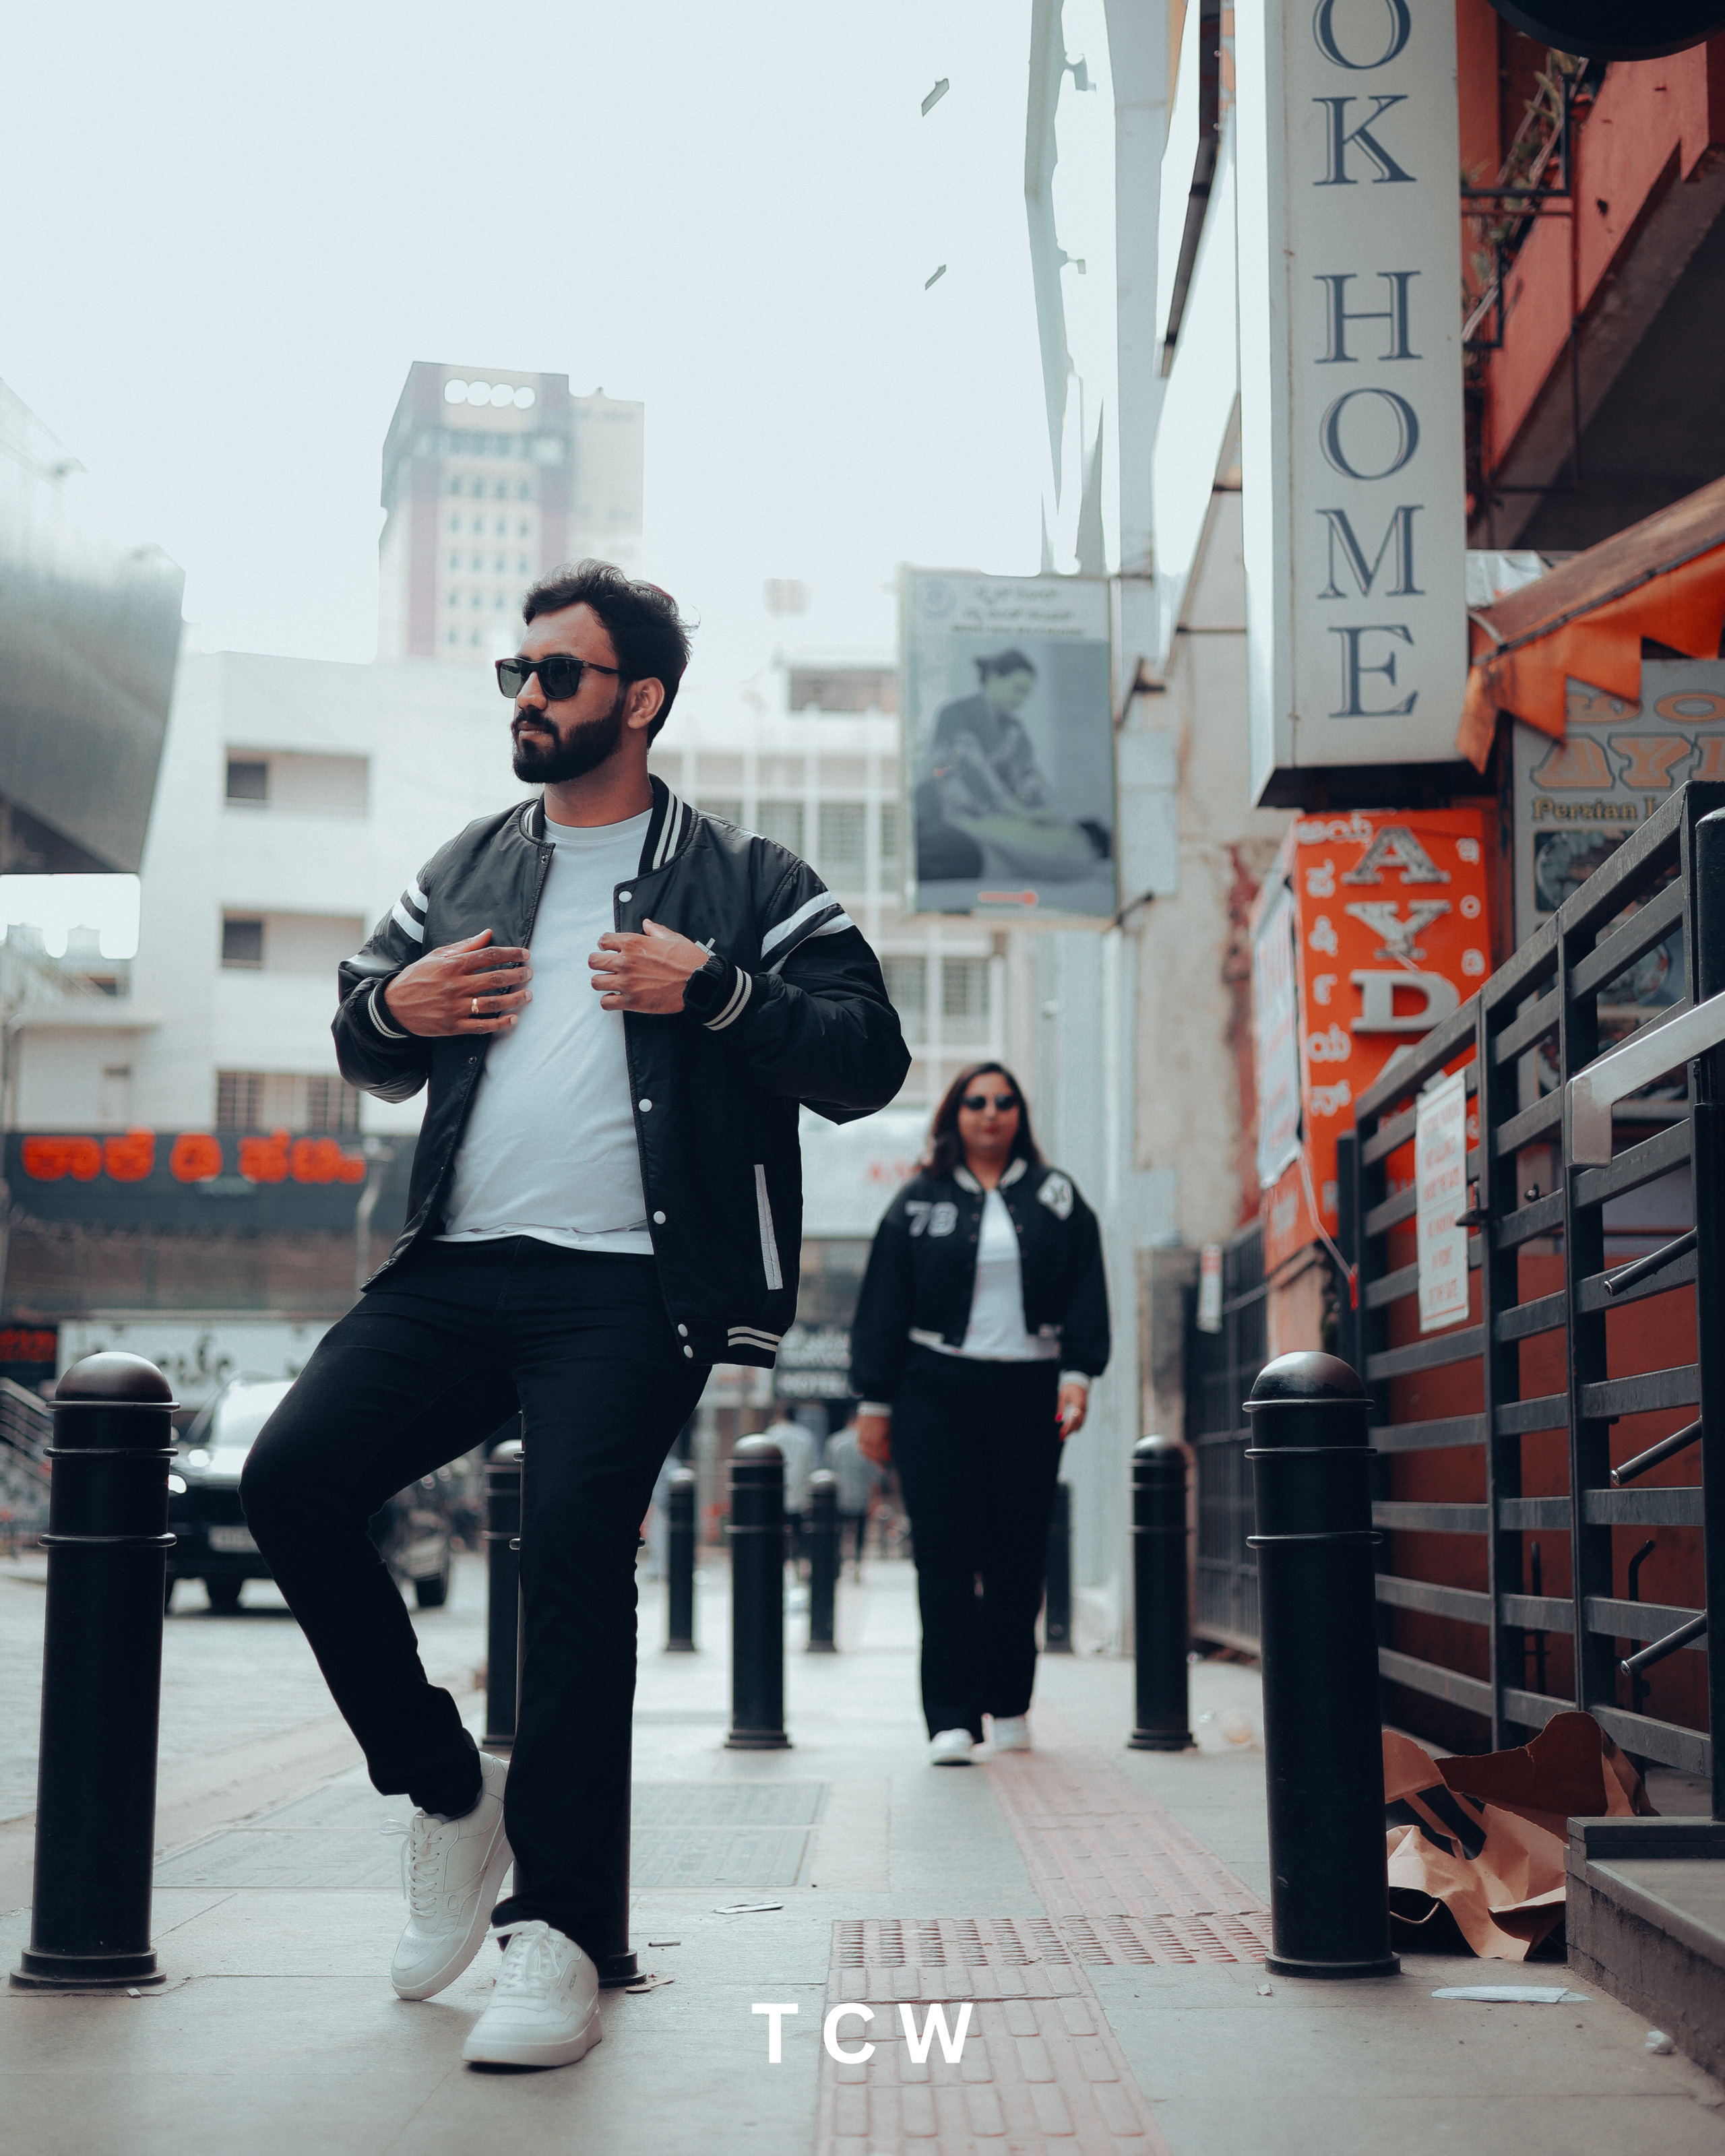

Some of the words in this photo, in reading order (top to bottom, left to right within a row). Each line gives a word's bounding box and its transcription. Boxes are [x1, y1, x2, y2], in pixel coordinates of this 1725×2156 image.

[1313, 270, 1426, 718] HOME
[1533, 797, 1636, 820] Persian
[1341, 825, 1461, 1093] AYD
